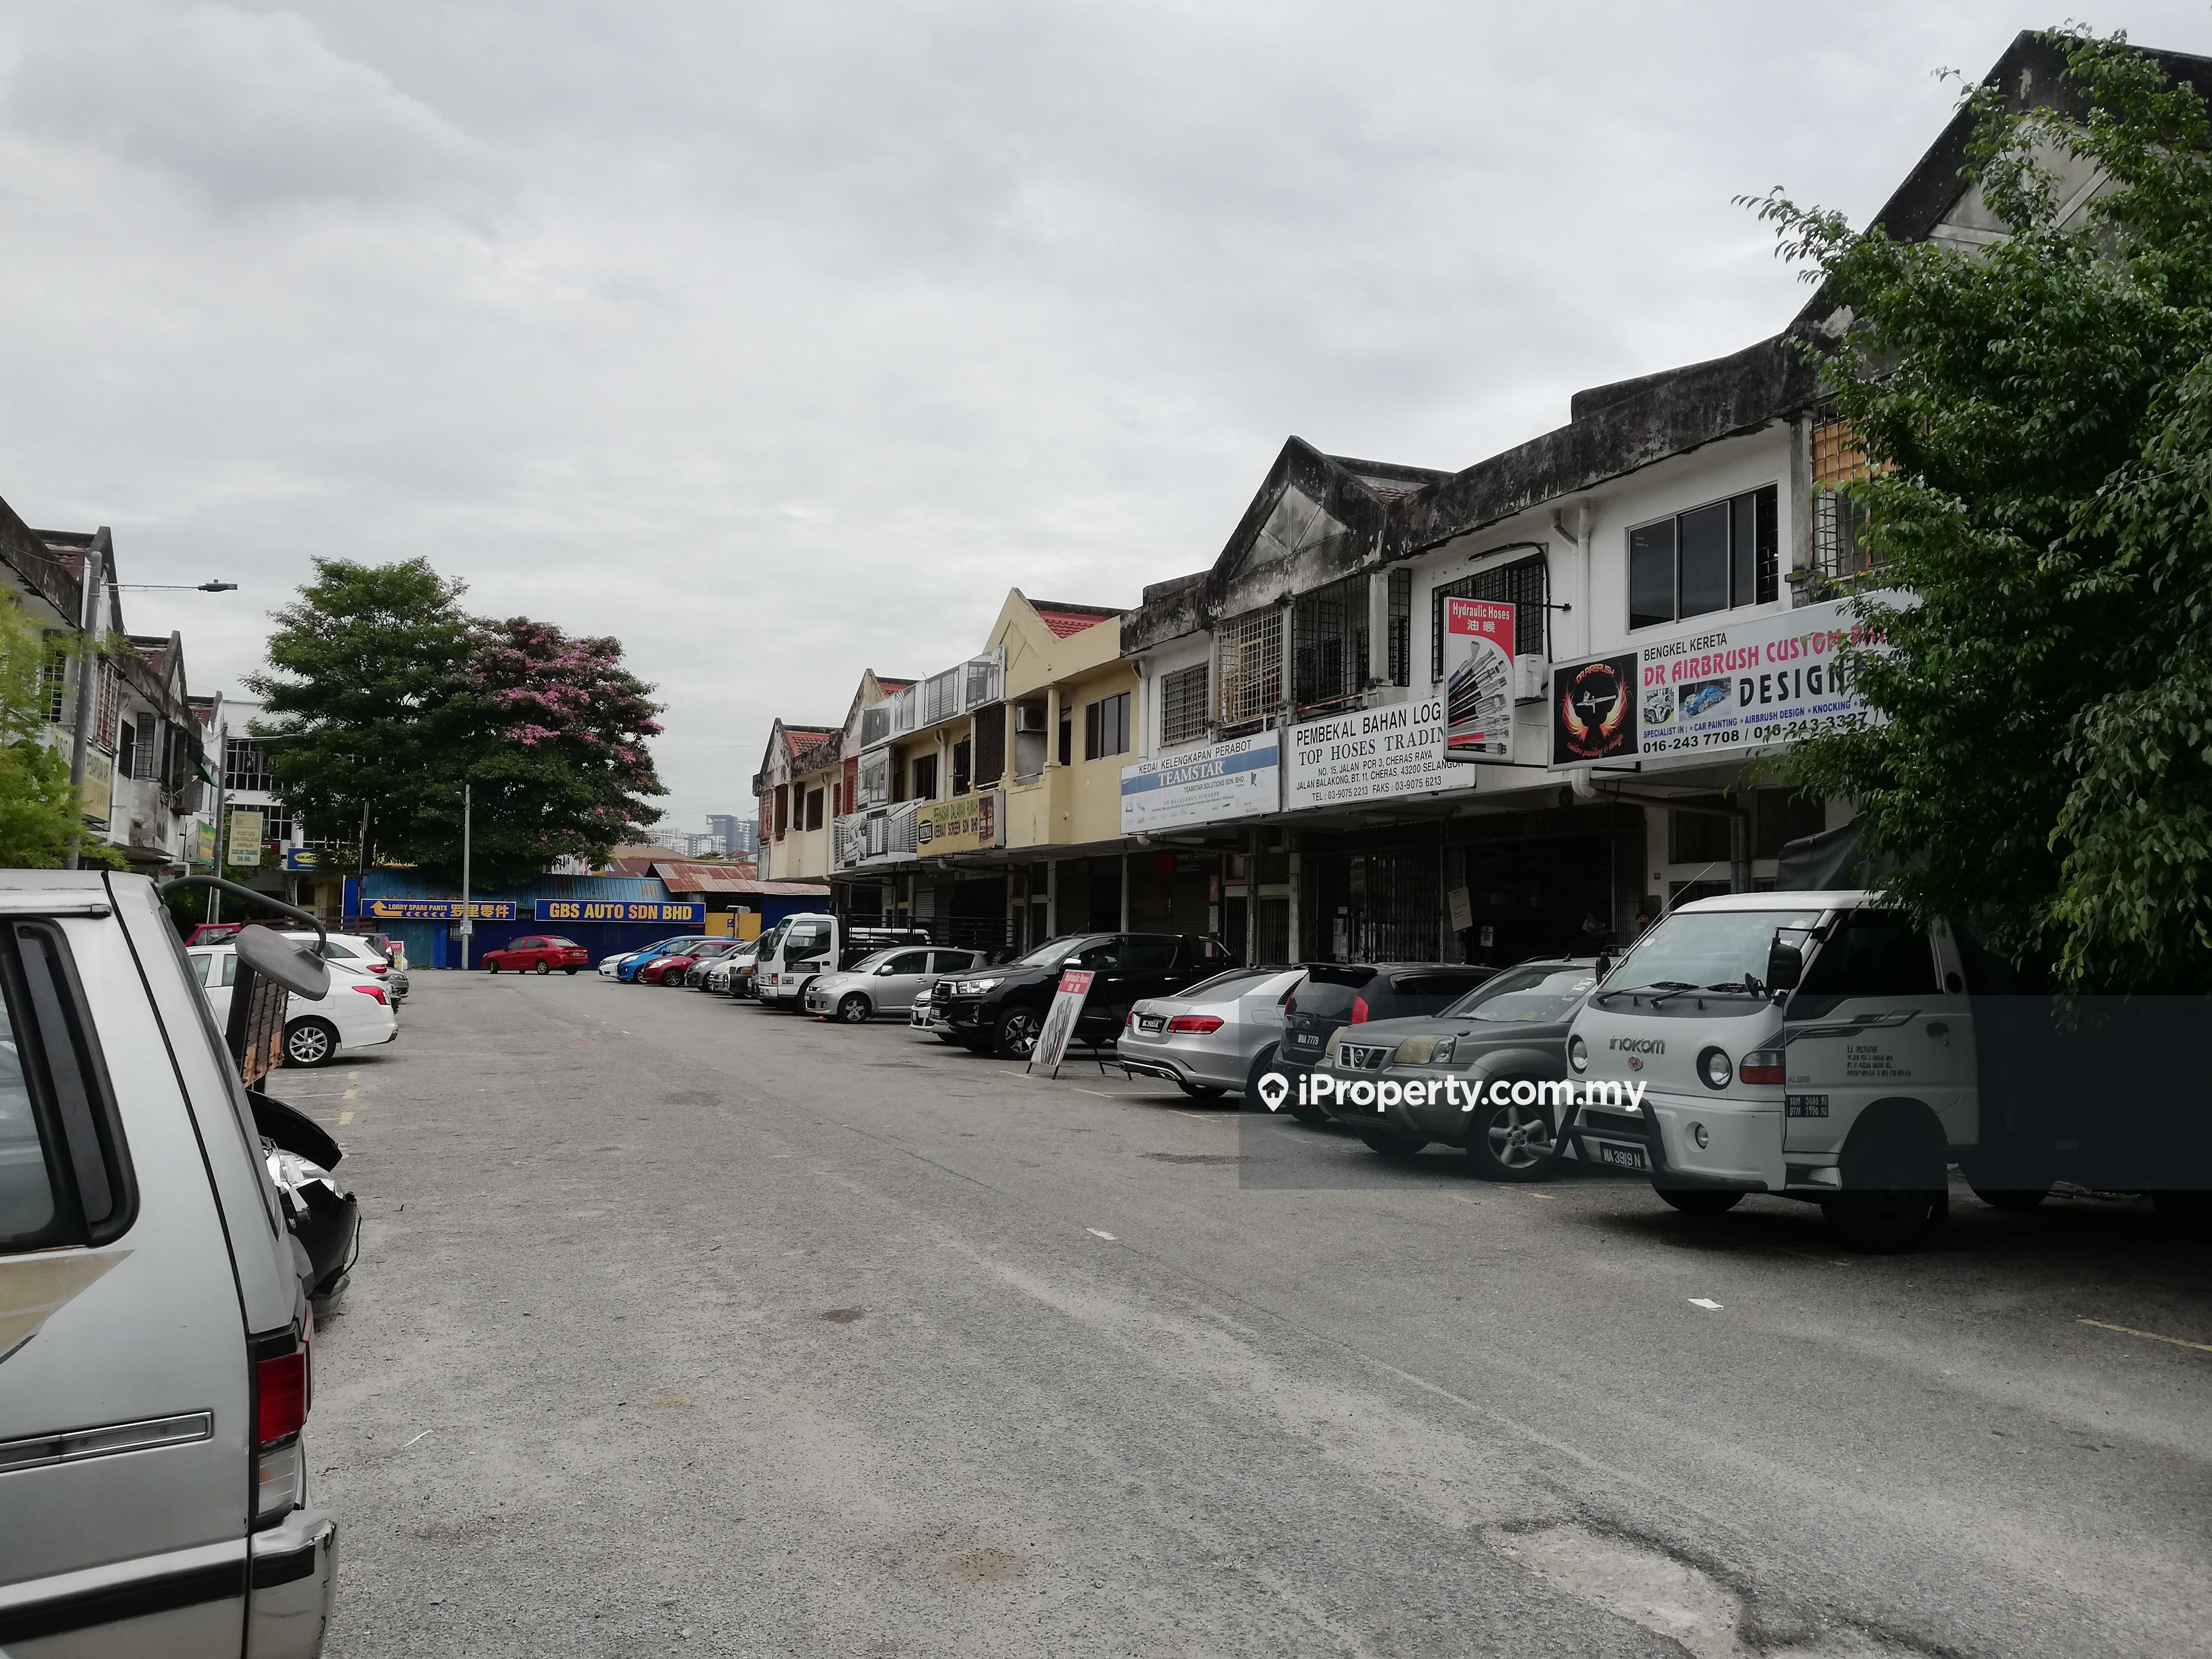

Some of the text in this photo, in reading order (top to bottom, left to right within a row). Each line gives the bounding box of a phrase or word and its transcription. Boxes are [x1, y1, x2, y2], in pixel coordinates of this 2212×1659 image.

[1453, 602, 1510, 620] Hydraulic Hoses
[1644, 633, 1727, 661] BENGKEL KERETA
[1644, 664, 1666, 686] DR
[1672, 645, 1759, 684] AIRBRUSH
[1297, 720, 1356, 747] PEMBEKAL
[1363, 709, 1407, 734] BAHAN
[1414, 702, 1443, 724] LOG
[1644, 727, 1676, 738] SPECIALIST
[1694, 722, 1706, 731] CAR
[1708, 718, 1737, 730] PAINTING
[1744, 711, 1778, 724] AIRBRUSH
[1780, 707, 1804, 719] DESIGN
[1813, 700, 1851, 714] KNOCKING
[1299, 726, 1444, 766] TOP HOSES TRADIN
[1643, 735, 1698, 753] 016-243
[1703, 730, 1739, 745] 7708
[1139, 740, 1251, 774] KEDAI KELENGKAPAN PERABOT
[1318, 767, 1328, 776] NO.
[1339, 762, 1359, 773] JALAN
[1363, 759, 1376, 769] PCR
[1379, 758, 1384, 768] 3,
[1386, 753, 1412, 766] CHERAS
[1415, 750, 1432, 761] RAYA
[1158, 760, 1225, 786] TEAMSTAR
[1297, 780, 1314, 790] JALAN
[1316, 775, 1350, 788] BALAKONG,
[1351, 773, 1360, 782] BT.
[1371, 767, 1399, 780] CHERAS,
[1401, 764, 1421, 775] 43200
[1184, 783, 1202, 793] TEAMSTAR
[1203, 780, 1225, 789] SOLUTIONS
[1312, 793, 1322, 801] TEL
[1328, 789, 1352, 799] 03-9075
[1354, 786, 1368, 796] 2213
[1373, 782, 1389, 794] FAKS
[1395, 778, 1423, 791] 03-9075
[1426, 776, 1442, 787] 6213
[550, 903, 692, 920] GBS AUTO SDN BHD
[1307, 1035, 1319, 1045] 7779
[1790, 1107, 1801, 1116] BTM
[1603, 1148, 1641, 1167] WA 3919 N
